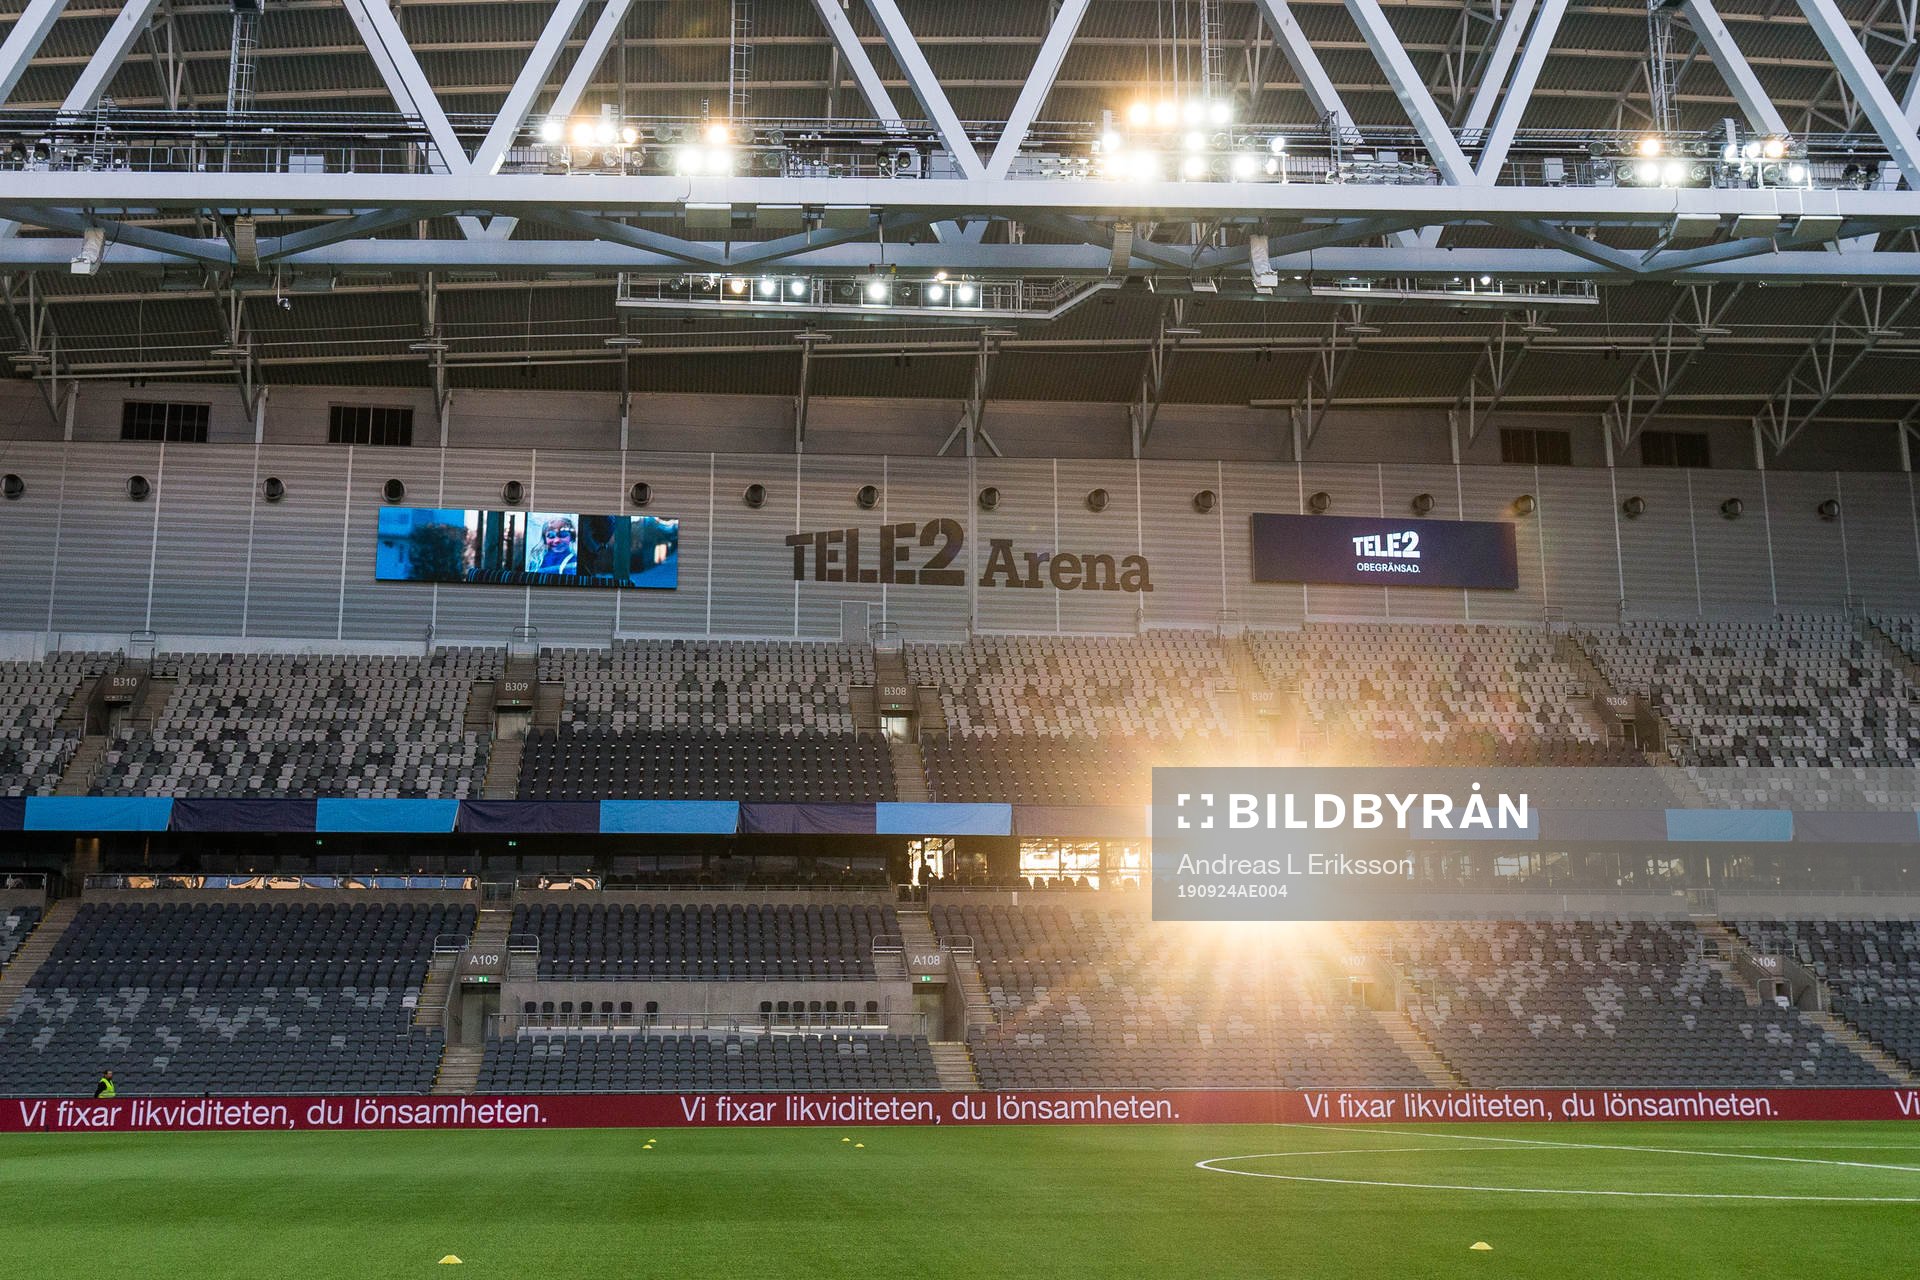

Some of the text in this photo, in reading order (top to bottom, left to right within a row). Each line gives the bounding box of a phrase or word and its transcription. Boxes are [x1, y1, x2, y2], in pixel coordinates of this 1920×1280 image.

[1353, 531, 1420, 558] TELE2
[785, 518, 1154, 593] TELE2 Arena
[1356, 562, 1421, 573] OBEGRÄNSAD.
[113, 677, 137, 687] B310
[505, 682, 528, 691] B309
[884, 687, 907, 696] B308
[470, 955, 499, 965] A109
[912, 955, 941, 966] A108
[680, 1094, 1180, 1125] Vi fixar likviditeten, du lönsamheten.
[1304, 1091, 1779, 1121] Vi fixar likviditeten, du lönsamheten.
[1894, 1091, 1920, 1115] Vi
[19, 1098, 548, 1129] Vi fixar likviditeten, du lönsamheten.
